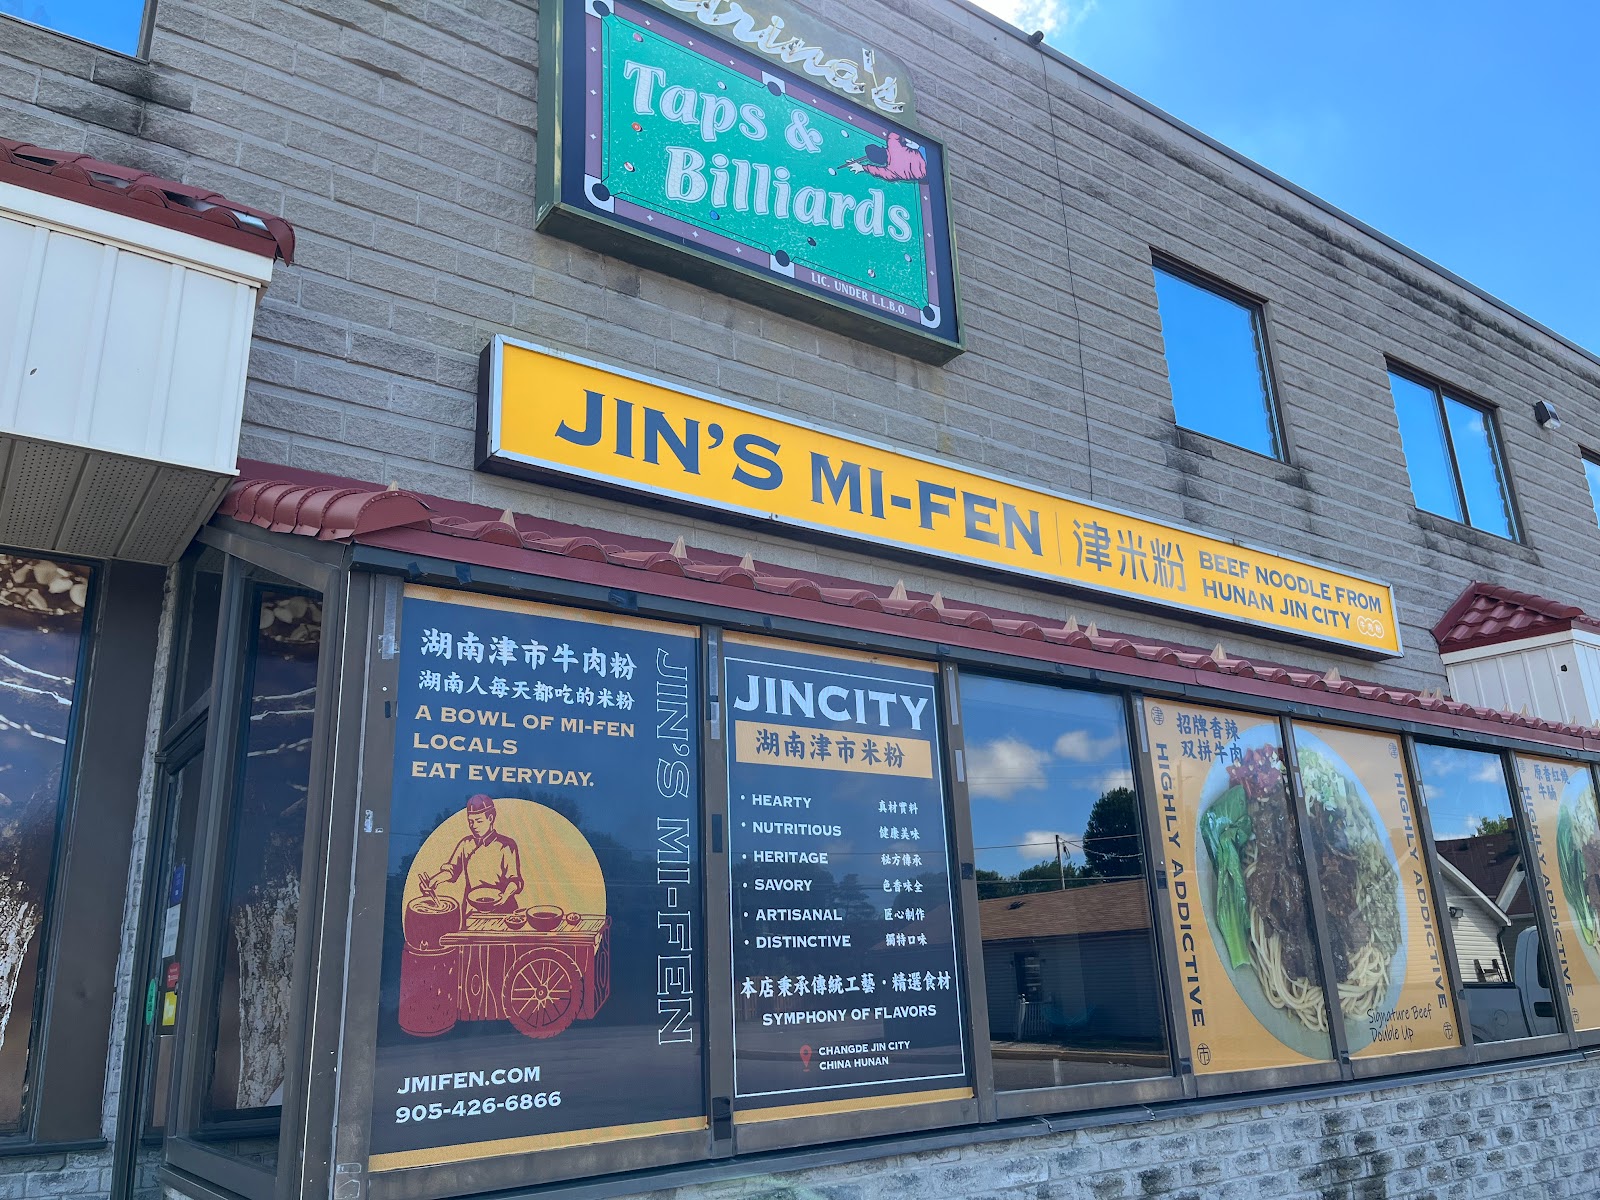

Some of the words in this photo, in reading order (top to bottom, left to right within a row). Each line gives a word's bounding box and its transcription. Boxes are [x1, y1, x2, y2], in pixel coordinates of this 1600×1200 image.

[623, 60, 767, 142] Taps
[784, 109, 824, 153] &
[665, 146, 912, 242] Billiards
[811, 272, 830, 287] LIC.
[834, 280, 868, 301] UNDER
[872, 294, 907, 315] L.L.B.O.
[555, 389, 784, 491] JIN'S
[809, 451, 1044, 556] MI-FEN
[1072, 519, 1187, 592] 津米粉
[1199, 551, 1250, 579] BEEF
[1255, 566, 1332, 600] NOODLE
[1335, 586, 1383, 613] FROM
[1202, 578, 1274, 612] HUNAN
[1280, 598, 1308, 620] JIN
[1311, 606, 1351, 629] CITY
[420, 628, 637, 680] 湖南津市牛肉粉
[418, 670, 636, 710] 湖南人每天都吃的米粉
[733, 674, 929, 731] JINCITY
[414, 705, 432, 721] A
[440, 707, 516, 729] BOWL
[522, 714, 554, 731] OF
[561, 717, 635, 738] MI-FEN
[656, 647, 690, 799] JIN'S
[1176, 712, 1240, 741] 招牌香辣
[413, 733, 518, 754] LOCALS
[755, 728, 905, 769] 湖南津市米粉
[1181, 739, 1242, 764] 双拼牛肉
[411, 761, 460, 779] EAT
[468, 764, 595, 787] EVERYDAY.
[752, 794, 812, 808] HEARTY
[752, 821, 842, 837] NUTRITIOUS
[879, 826, 920, 840] 健康美味
[753, 850, 828, 864] HERITAGE
[754, 879, 812, 891] SAVORY
[883, 879, 923, 893] 色香味全
[1156, 743, 1180, 848] HIGHLY
[1171, 859, 1206, 1027] ADDICTIVE
[1394, 773, 1419, 861] HIGHLY
[1413, 870, 1447, 1009] ADDICTIVE
[1524, 786, 1547, 865] HIGHLY
[1541, 874, 1574, 997] ADDICTIVE
[755, 909, 842, 921] ARTISANAL
[657, 817, 693, 1045] MI-FEN
[756, 935, 851, 949] DISTINCTIVE
[762, 1009, 847, 1026] SYMPHONY
[851, 1007, 871, 1021] OF
[874, 1005, 937, 1019] FLAVORS
[1367, 1008, 1410, 1028] Signature
[1411, 1003, 1432, 1019] Beef
[818, 1043, 869, 1056] CHANGDE
[871, 1042, 886, 1052] JIN
[888, 1041, 911, 1051] CITY
[1369, 1024, 1399, 1042] Double
[1401, 1025, 1413, 1042] Up
[819, 1058, 851, 1071] CHINA
[854, 1056, 889, 1068] HUNAN
[397, 1066, 541, 1094] JMIFEN.COM
[395, 1091, 562, 1124] 905-426-6866
